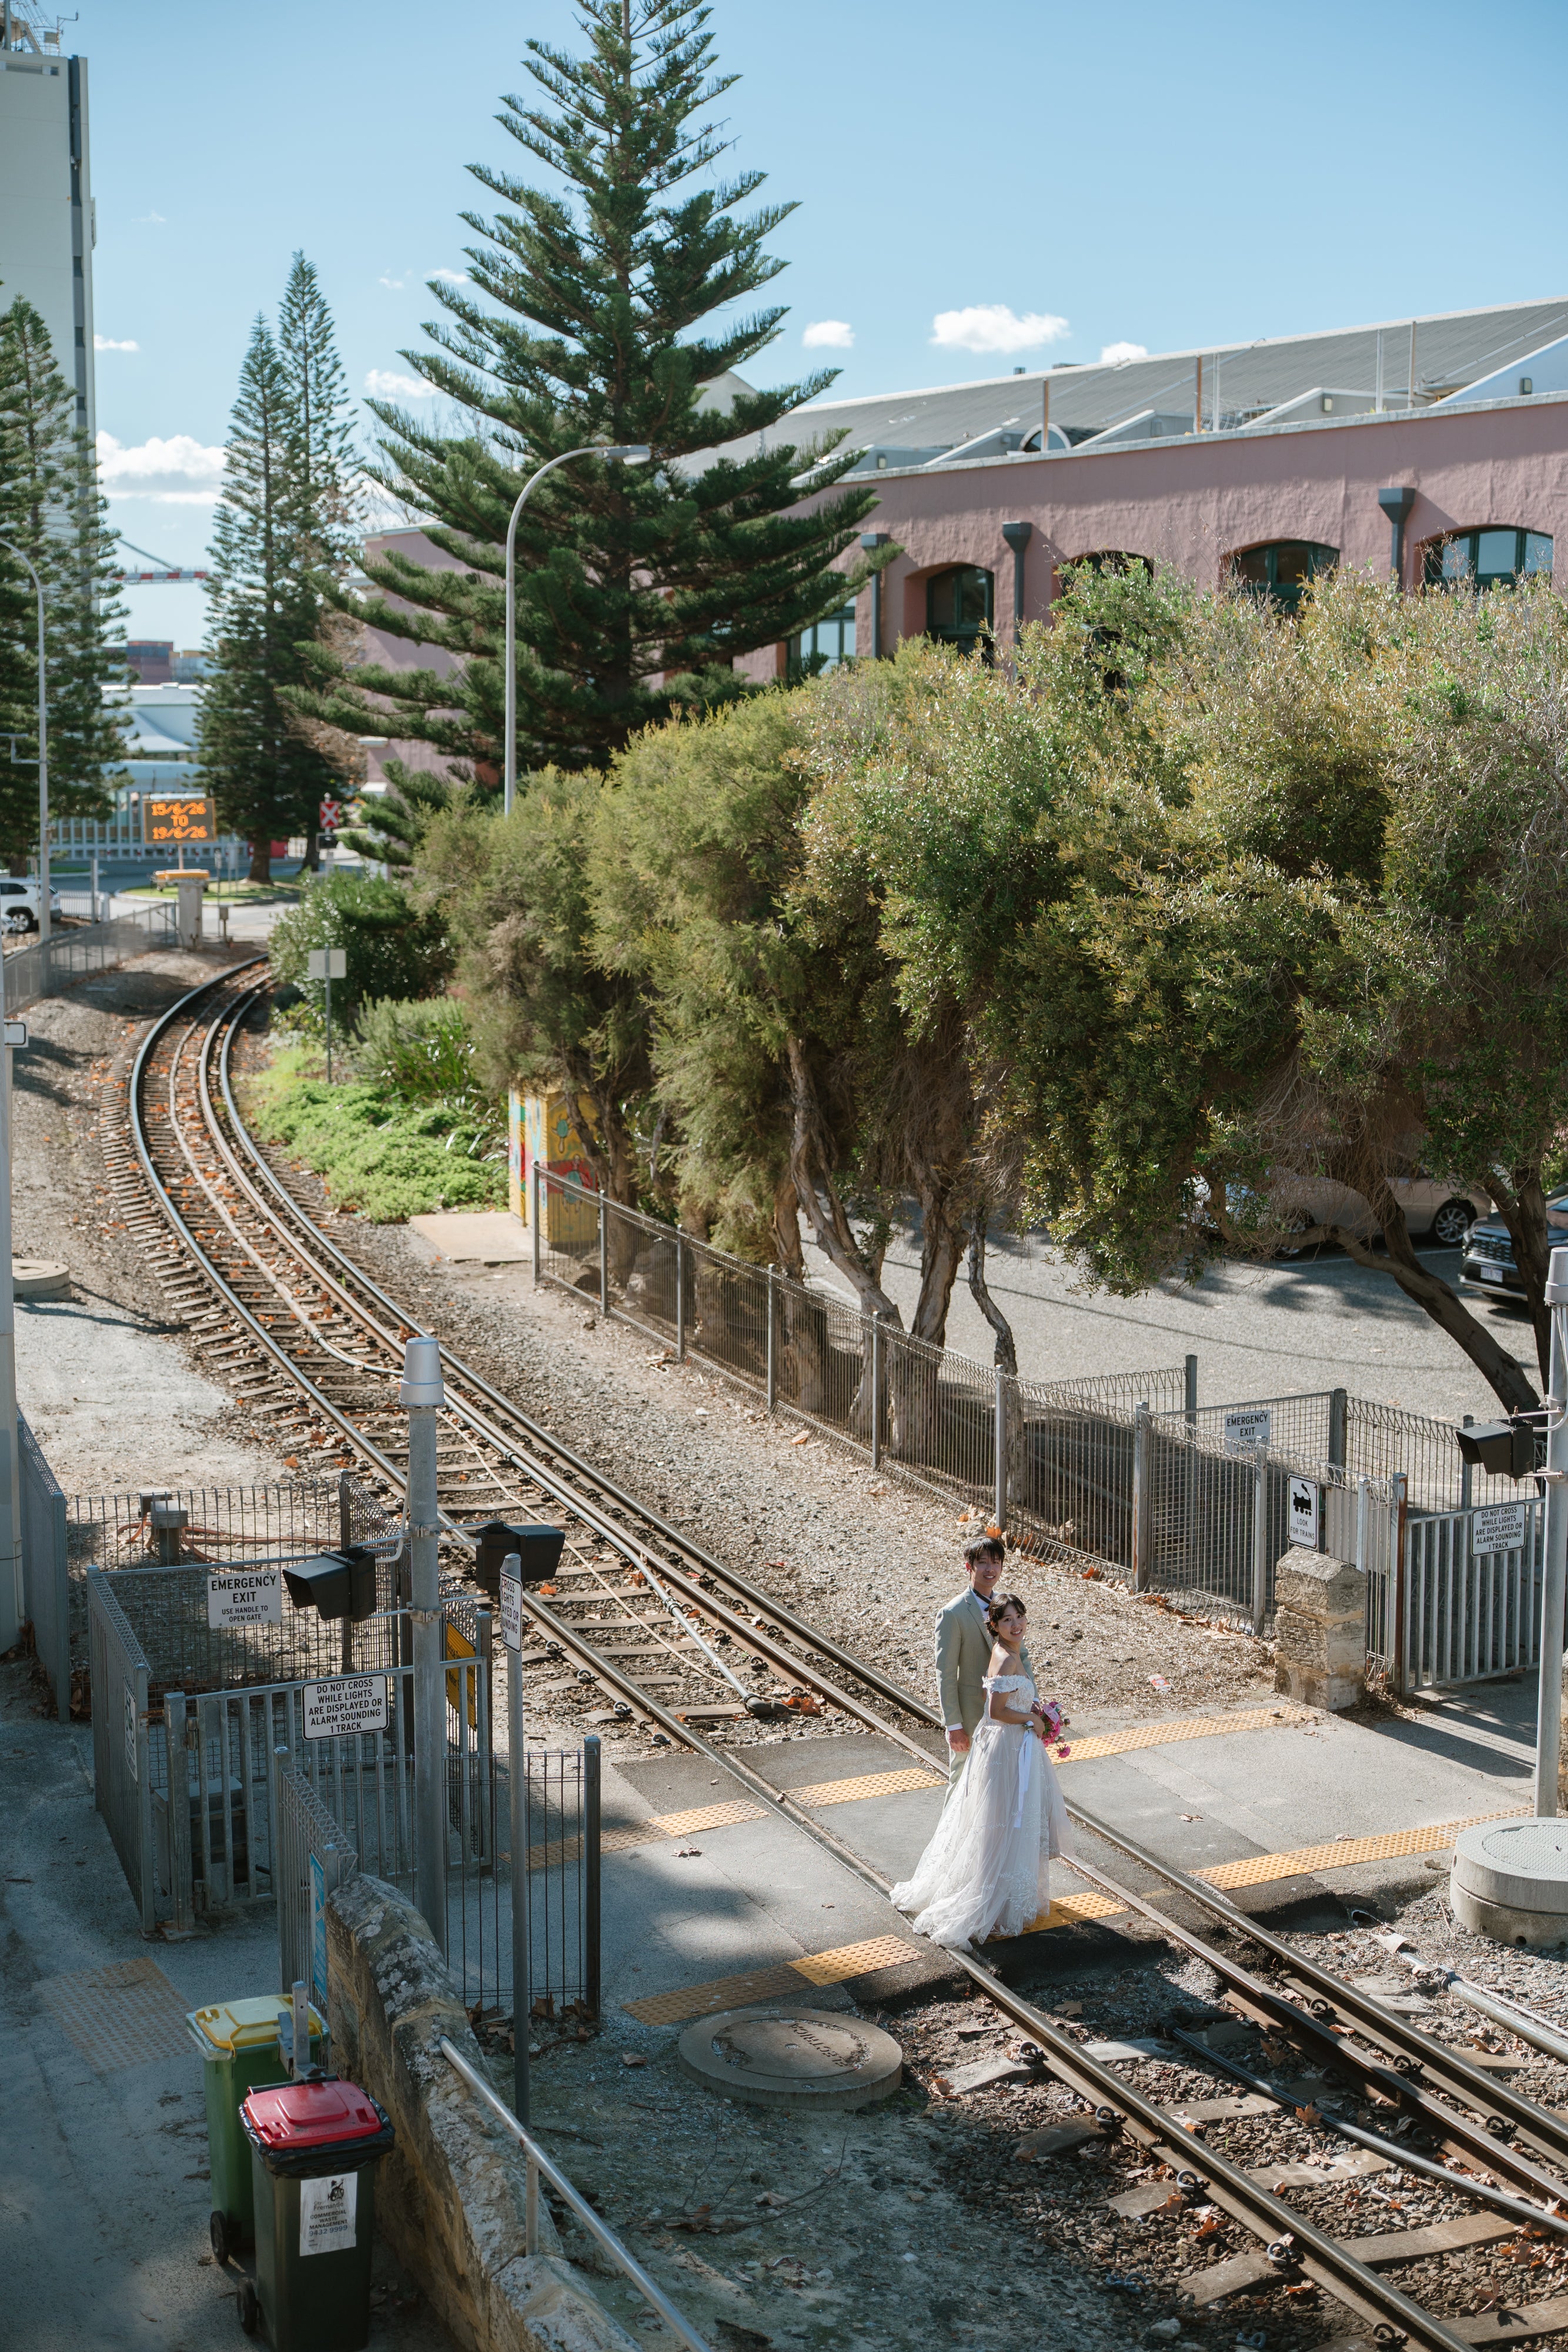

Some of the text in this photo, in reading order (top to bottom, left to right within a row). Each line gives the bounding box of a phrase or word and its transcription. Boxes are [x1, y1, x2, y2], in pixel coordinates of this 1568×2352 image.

[152, 803, 207, 816] 15/6/26
[170, 814, 189, 827] TO
[1227, 1414, 1268, 1426] EMERGENCY
[1240, 1427, 1255, 1436] EXIT
[1501, 1506, 1517, 1515] CROSS
[1297, 1518, 1308, 1527] LOOK
[1482, 1515, 1516, 1526] WHILE LIGHTS
[1290, 1526, 1315, 1540] FOR TRAINS
[1487, 1524, 1513, 1534] DISPLAYED
[1476, 1531, 1520, 1544] ALARM SOUNDING
[1492, 1541, 1509, 1550] TRACK
[212, 1575, 276, 1591] EMERGENCY
[502, 1578, 515, 1593] CROSS
[233, 1592, 256, 1603] EXIT
[502, 1592, 514, 1606] IGHTS
[513, 1610, 519, 1622] OR
[502, 1619, 518, 1634] UNDING
[317, 1679, 373, 1693] DO NOT CROSS
[318, 1689, 372, 1703] WHILE LIGHTS
[309, 1698, 382, 1715] ARE DISPLAYED OR
[310, 1709, 381, 1726] ALARM SOUNDING
[336, 1722, 362, 1732] TRACK
[313, 2201, 343, 2211] Fremantle
[310, 2210, 346, 2219] COMMERCIAL
[309, 2220, 347, 2230] MANAGEMENT
[330, 2224, 347, 2233] 9999
